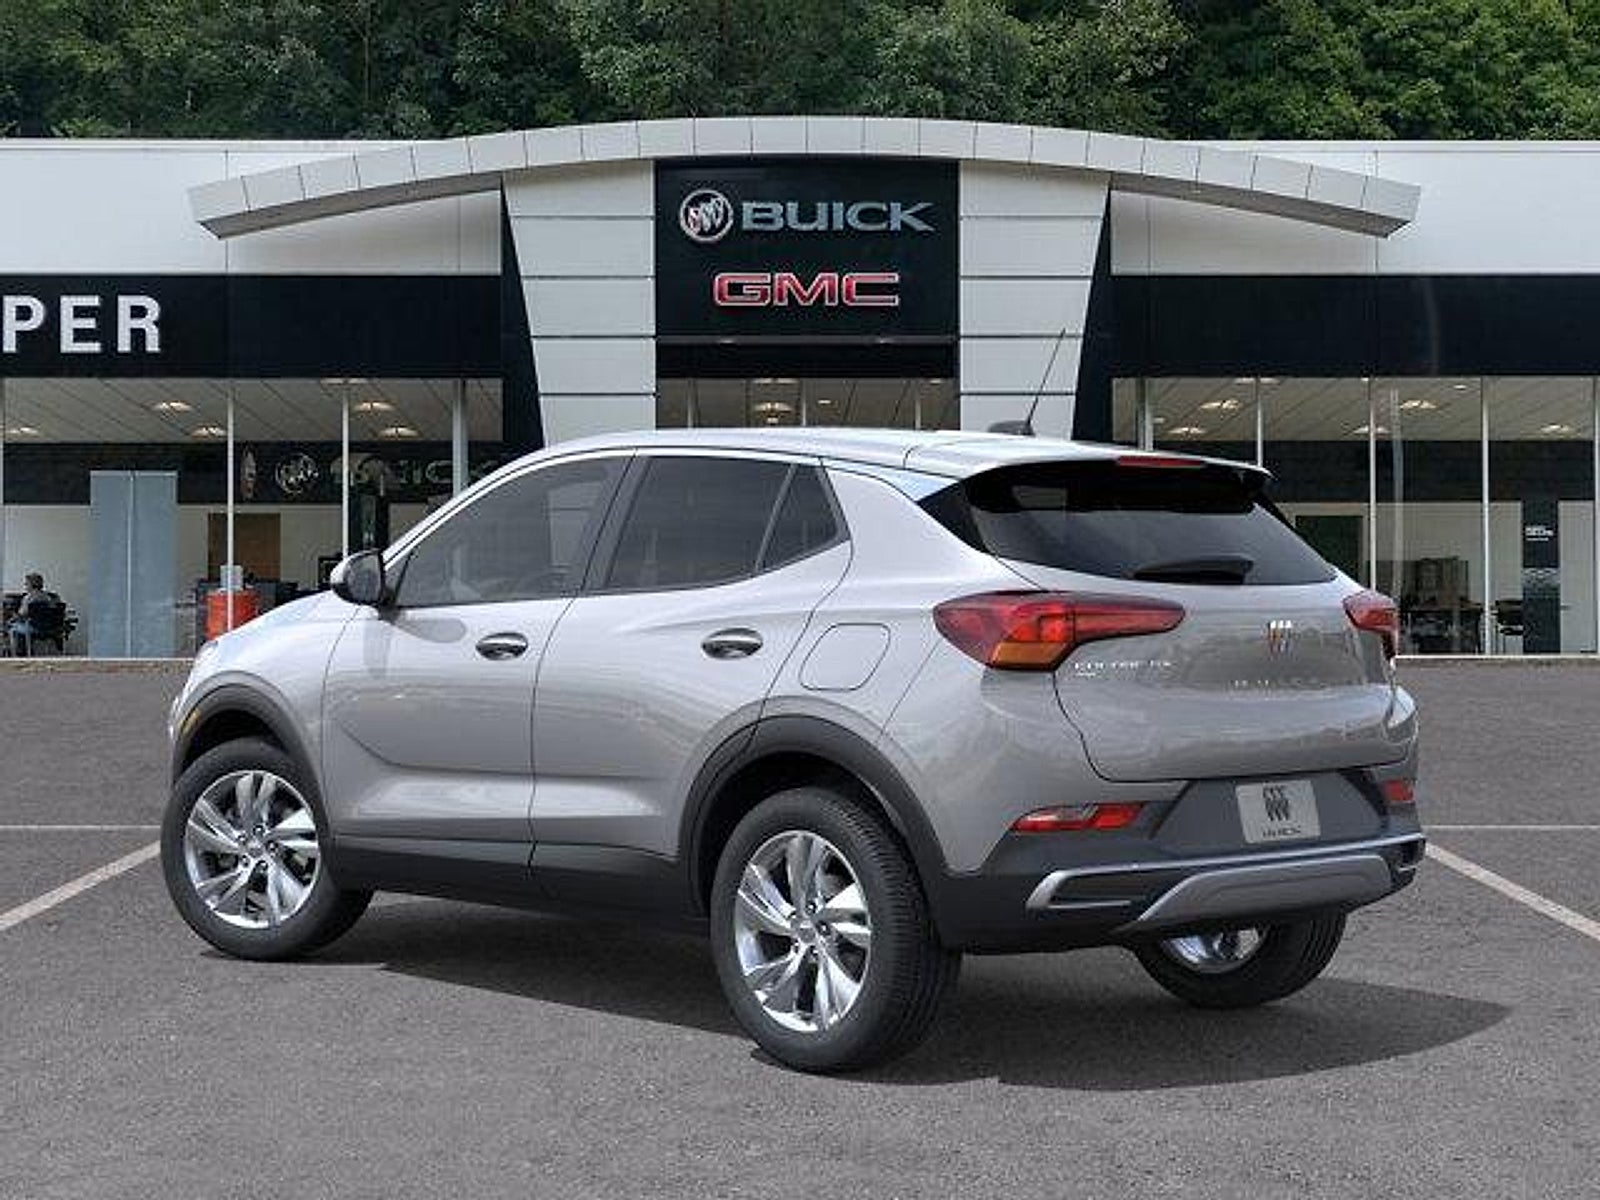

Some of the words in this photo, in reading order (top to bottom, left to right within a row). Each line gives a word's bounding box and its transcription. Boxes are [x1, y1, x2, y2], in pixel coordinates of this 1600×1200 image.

[741, 201, 936, 233] BUICK
[713, 272, 900, 307] GMC
[2, 294, 162, 354] PER
